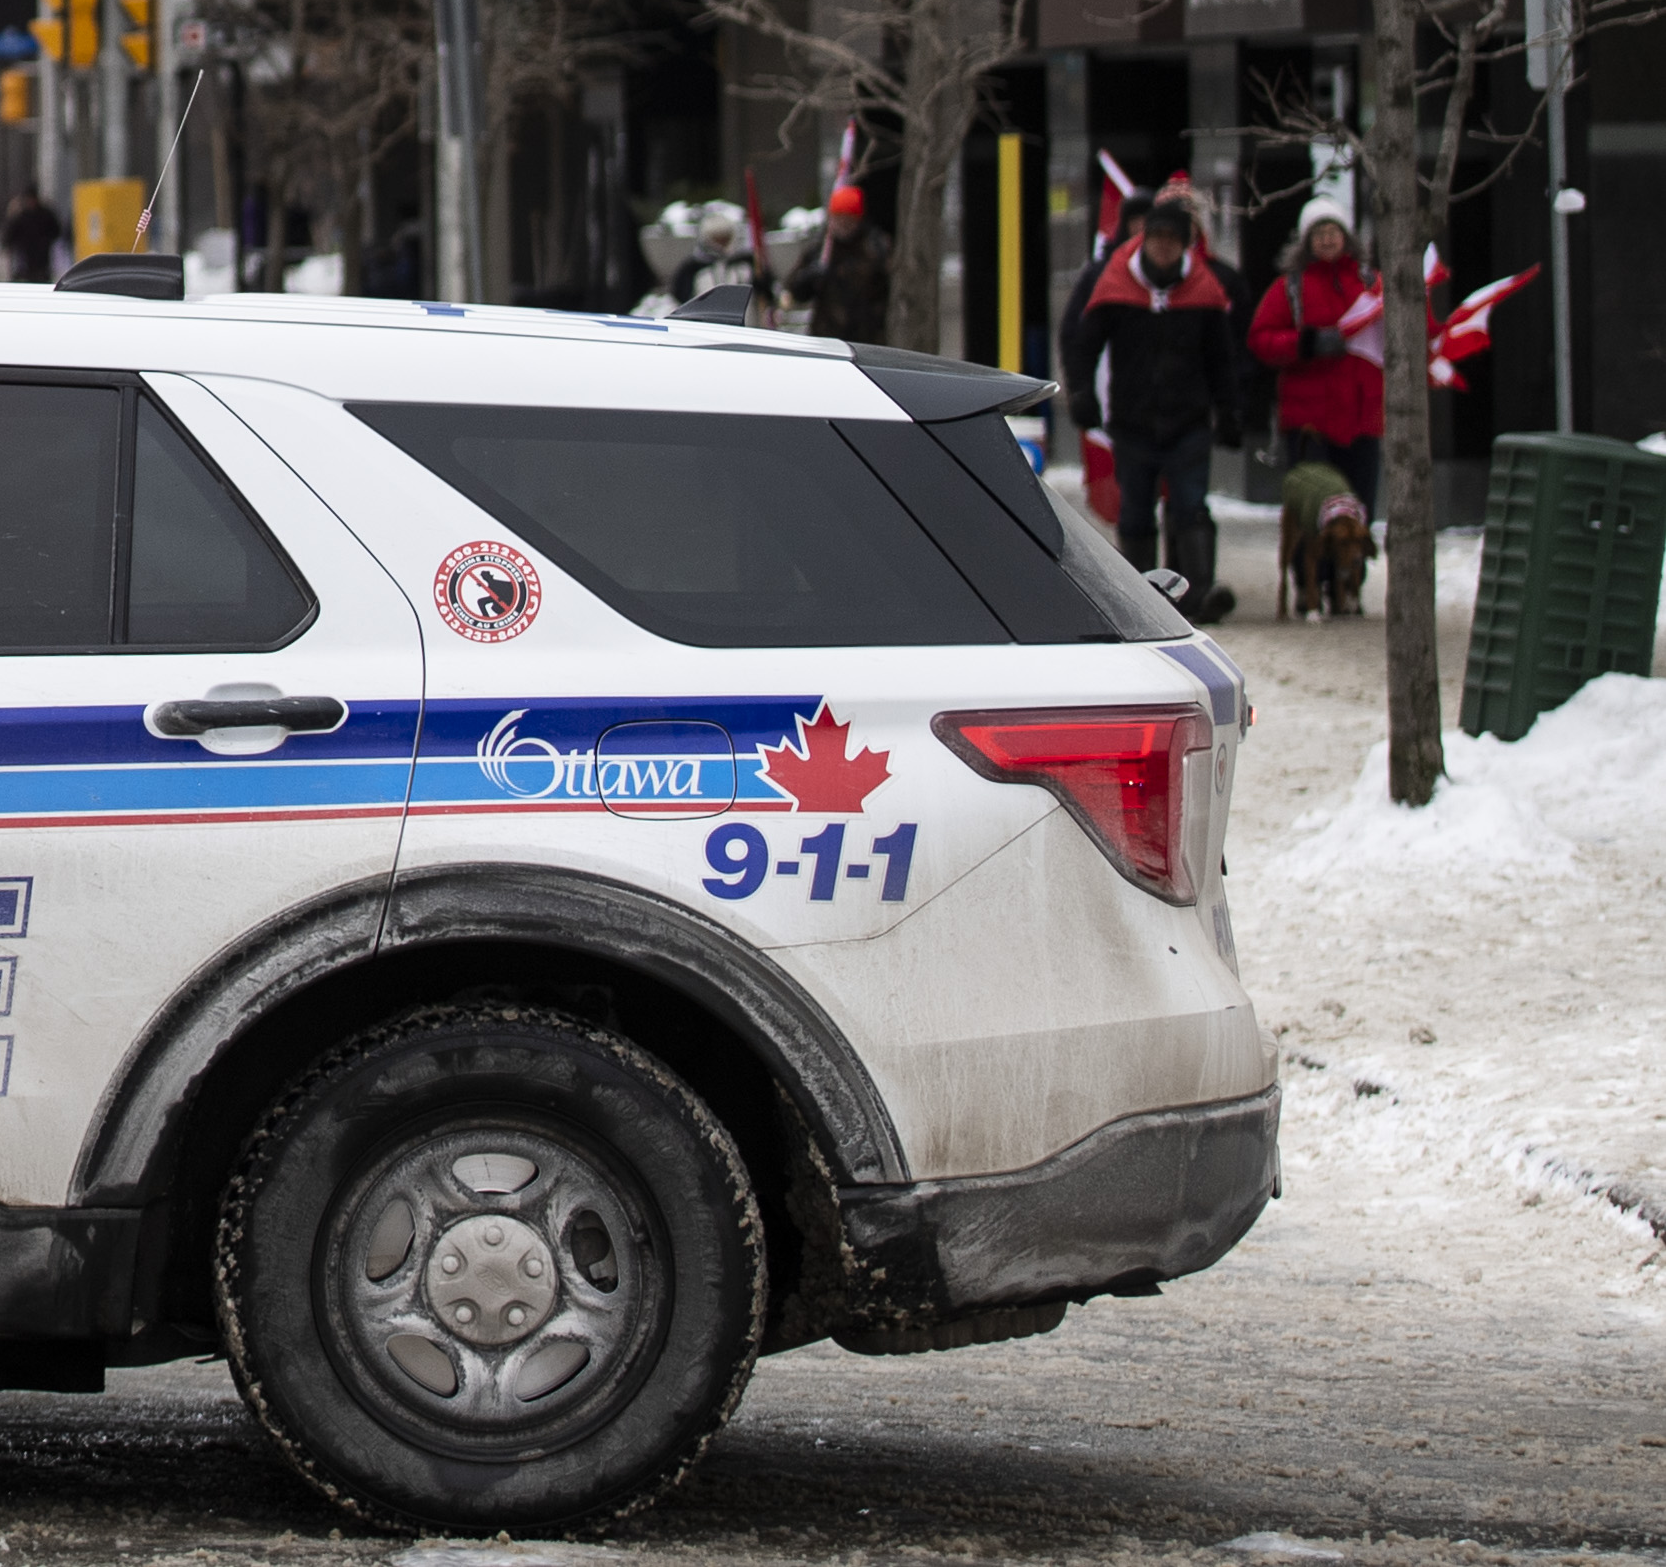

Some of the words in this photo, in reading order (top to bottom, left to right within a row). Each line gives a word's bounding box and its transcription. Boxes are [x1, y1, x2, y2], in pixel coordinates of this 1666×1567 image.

[438, 542, 540, 593] 1-800-222-8477
[456, 555, 481, 574] CRIME
[483, 555, 524, 583] STOPPERS
[439, 604, 529, 642] 613-233-8477
[476, 620, 491, 629] AU
[493, 610, 519, 629] CRIME
[478, 713, 703, 798] Ottawa
[701, 822, 918, 902] 9-1-1
